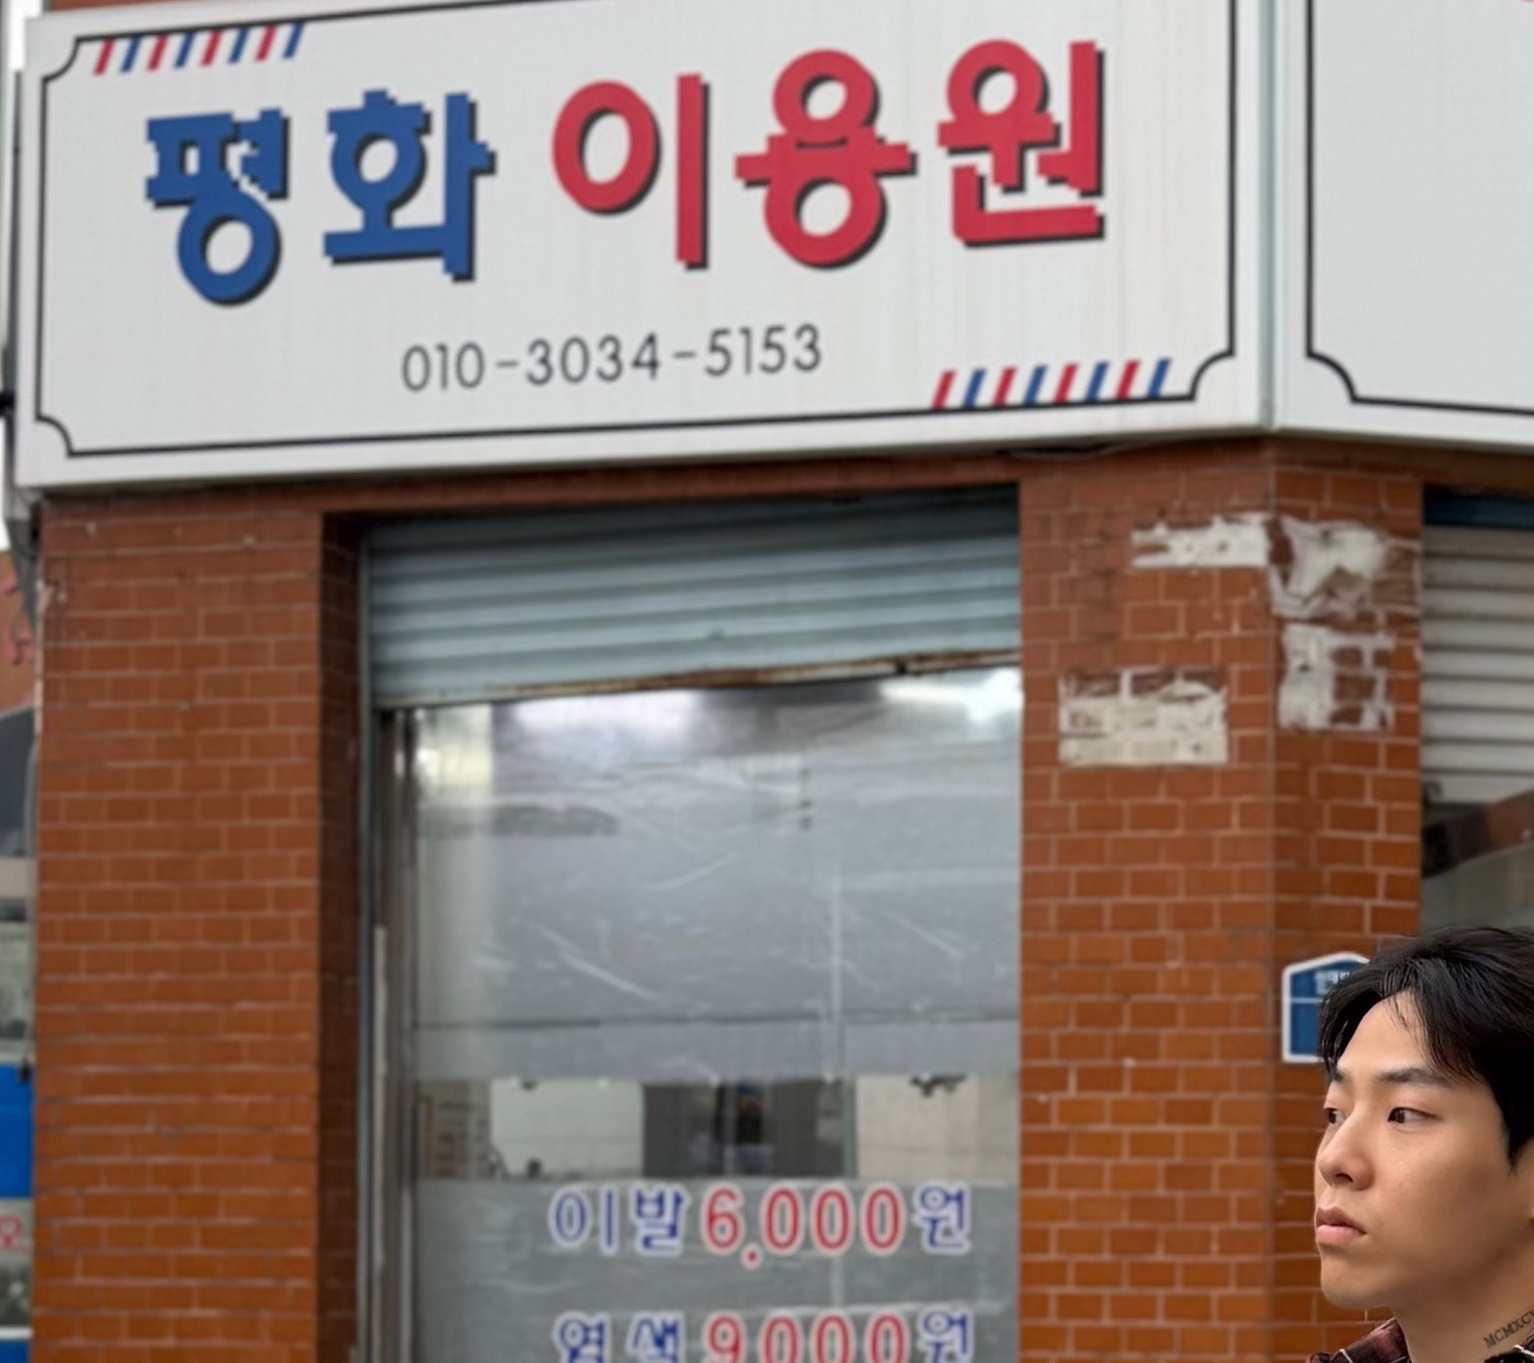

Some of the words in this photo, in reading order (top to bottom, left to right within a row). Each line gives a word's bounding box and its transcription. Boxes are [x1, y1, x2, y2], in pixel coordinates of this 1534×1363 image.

[145, 88, 498, 306] 평화
[551, 40, 1106, 272] 이용원
[402, 324, 822, 392] 010-3034-5153
[550, 1187, 688, 1254] 이발
